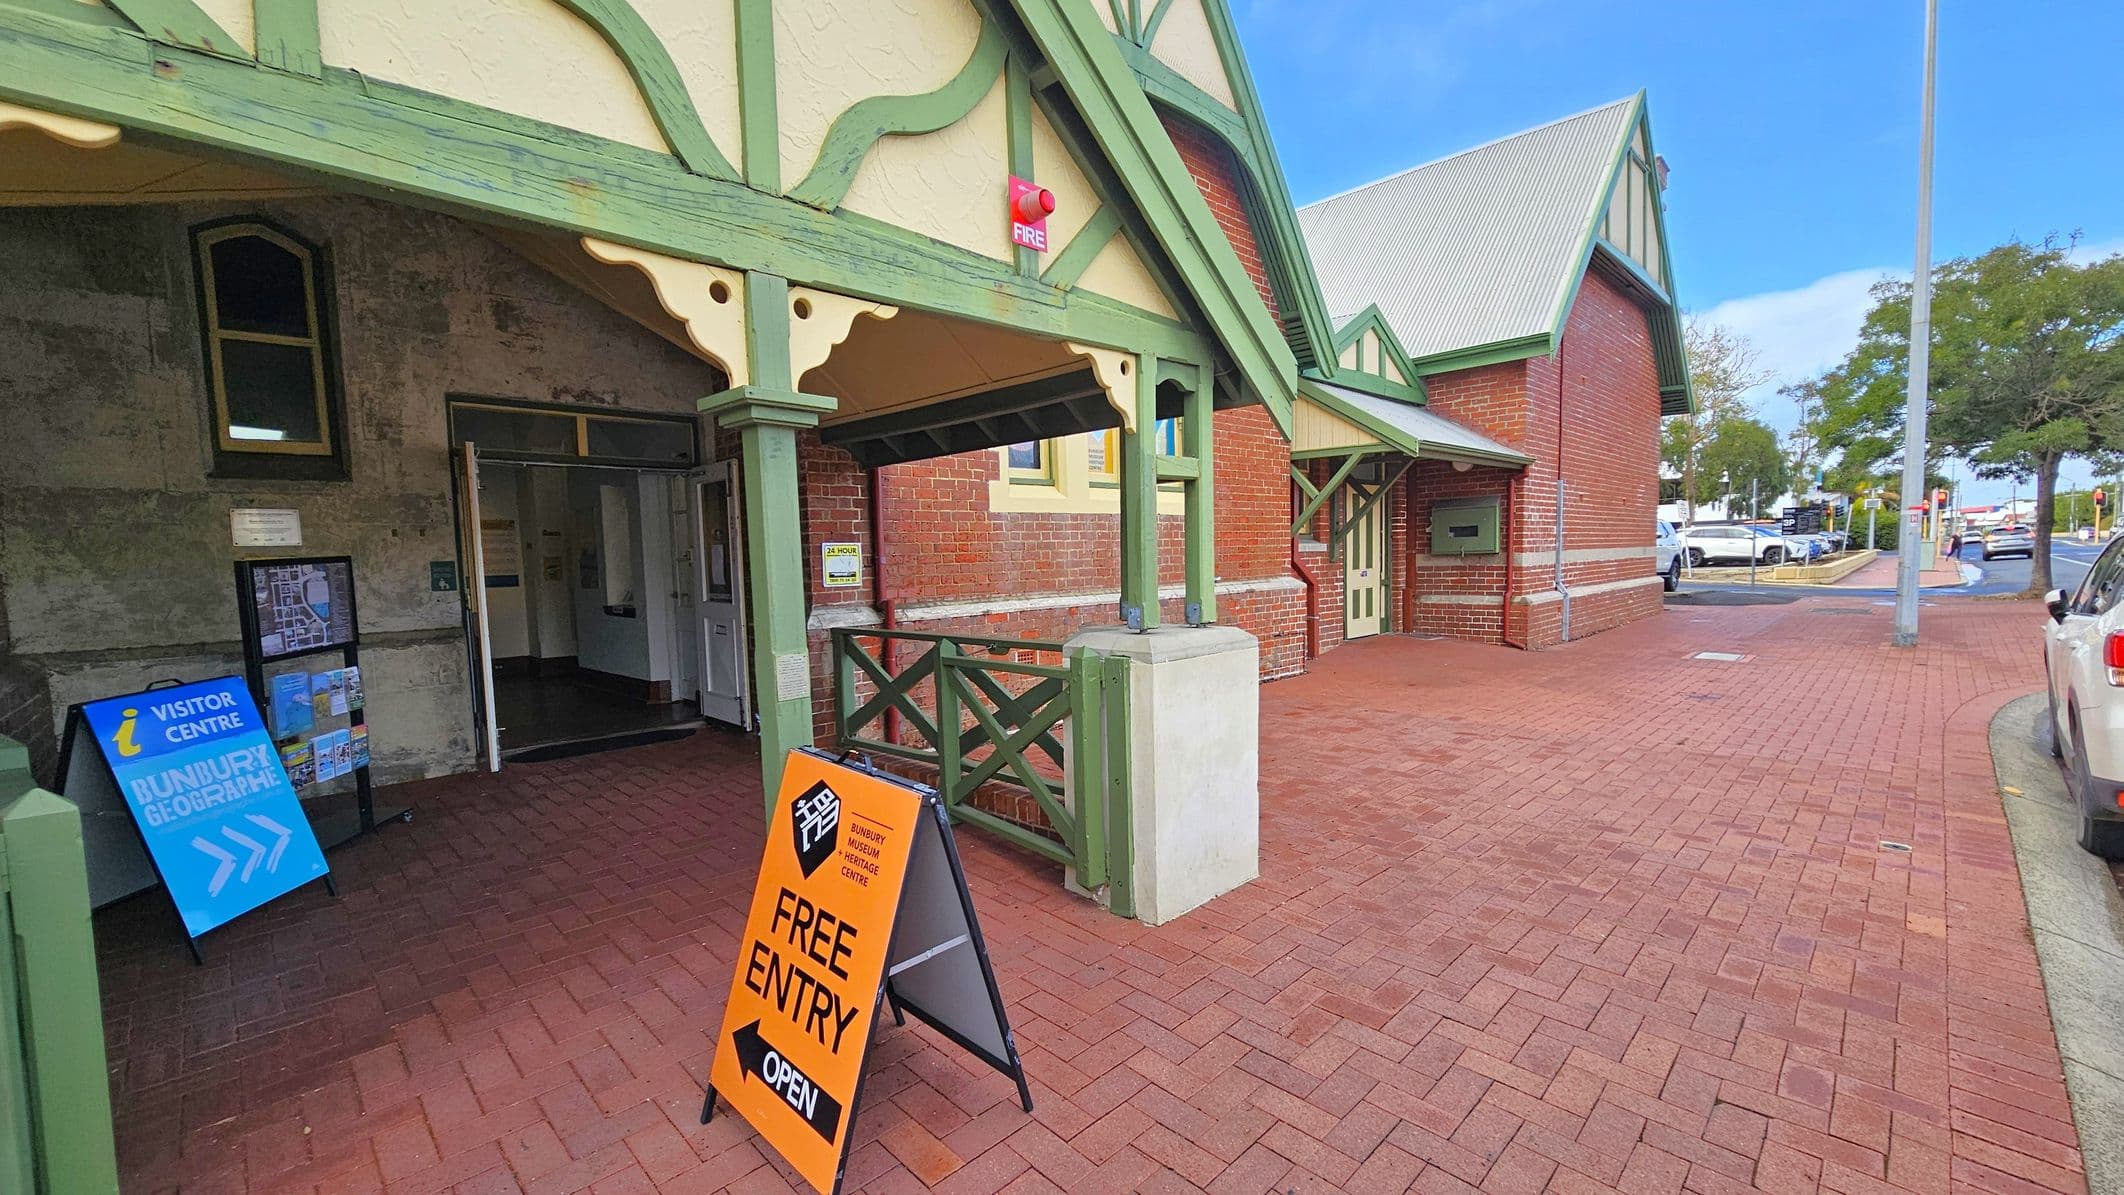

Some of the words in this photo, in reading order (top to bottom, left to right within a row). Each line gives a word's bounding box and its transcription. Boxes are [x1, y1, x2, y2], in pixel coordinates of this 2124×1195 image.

[1013, 222, 1045, 248] FIRE
[151, 692, 237, 721] VISITOR
[165, 712, 244, 743] CENTRE
[130, 744, 271, 805] BUNBURY
[144, 766, 282, 827] GEOGRAPHE
[847, 836, 880, 860] MUSEUM
[850, 822, 886, 846] BUNBURY
[841, 865, 869, 887] CENTRE
[844, 851, 880, 876] HERITAGE
[771, 886, 858, 982] FREE
[745, 939, 859, 1055] ENTRY
[762, 1050, 819, 1121] OPEN
